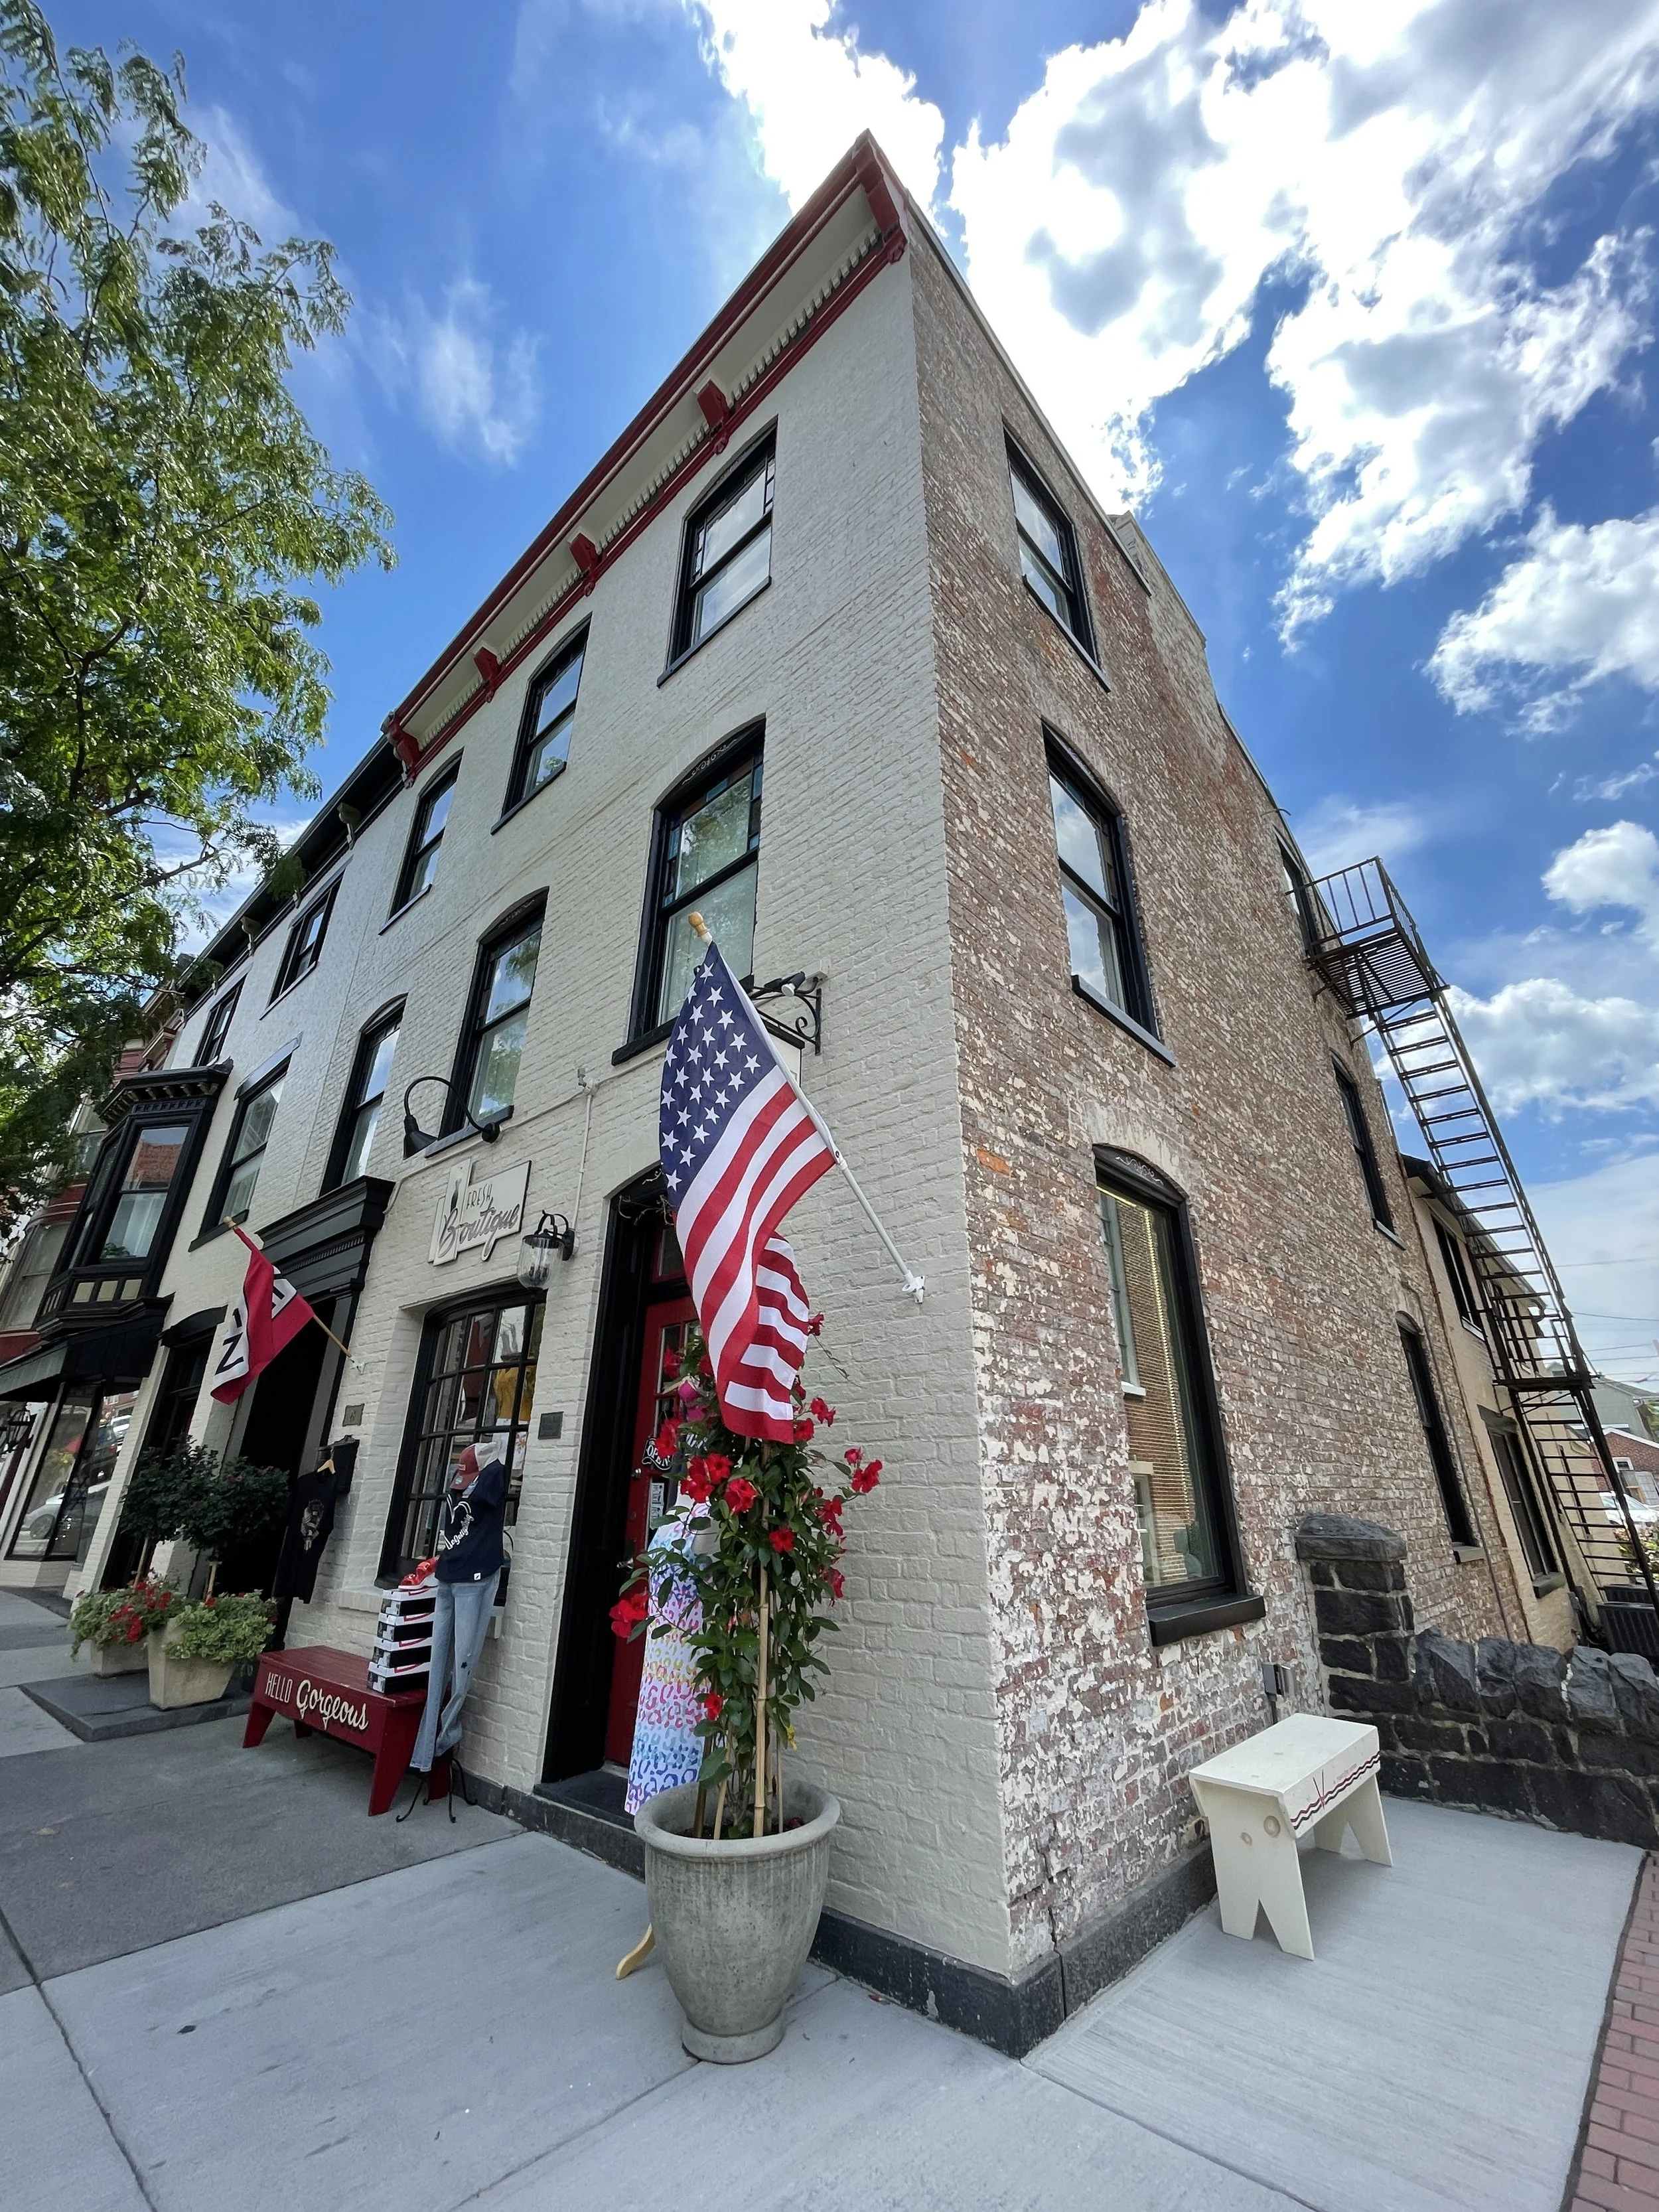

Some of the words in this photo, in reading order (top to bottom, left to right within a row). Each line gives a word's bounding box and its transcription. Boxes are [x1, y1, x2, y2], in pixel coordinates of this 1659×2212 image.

[466, 1183, 492, 1209] FRESH
[438, 1197, 520, 1258] Boutique
[265, 1672, 293, 1703] HELLO
[296, 1679, 368, 1730] Gorgeous
